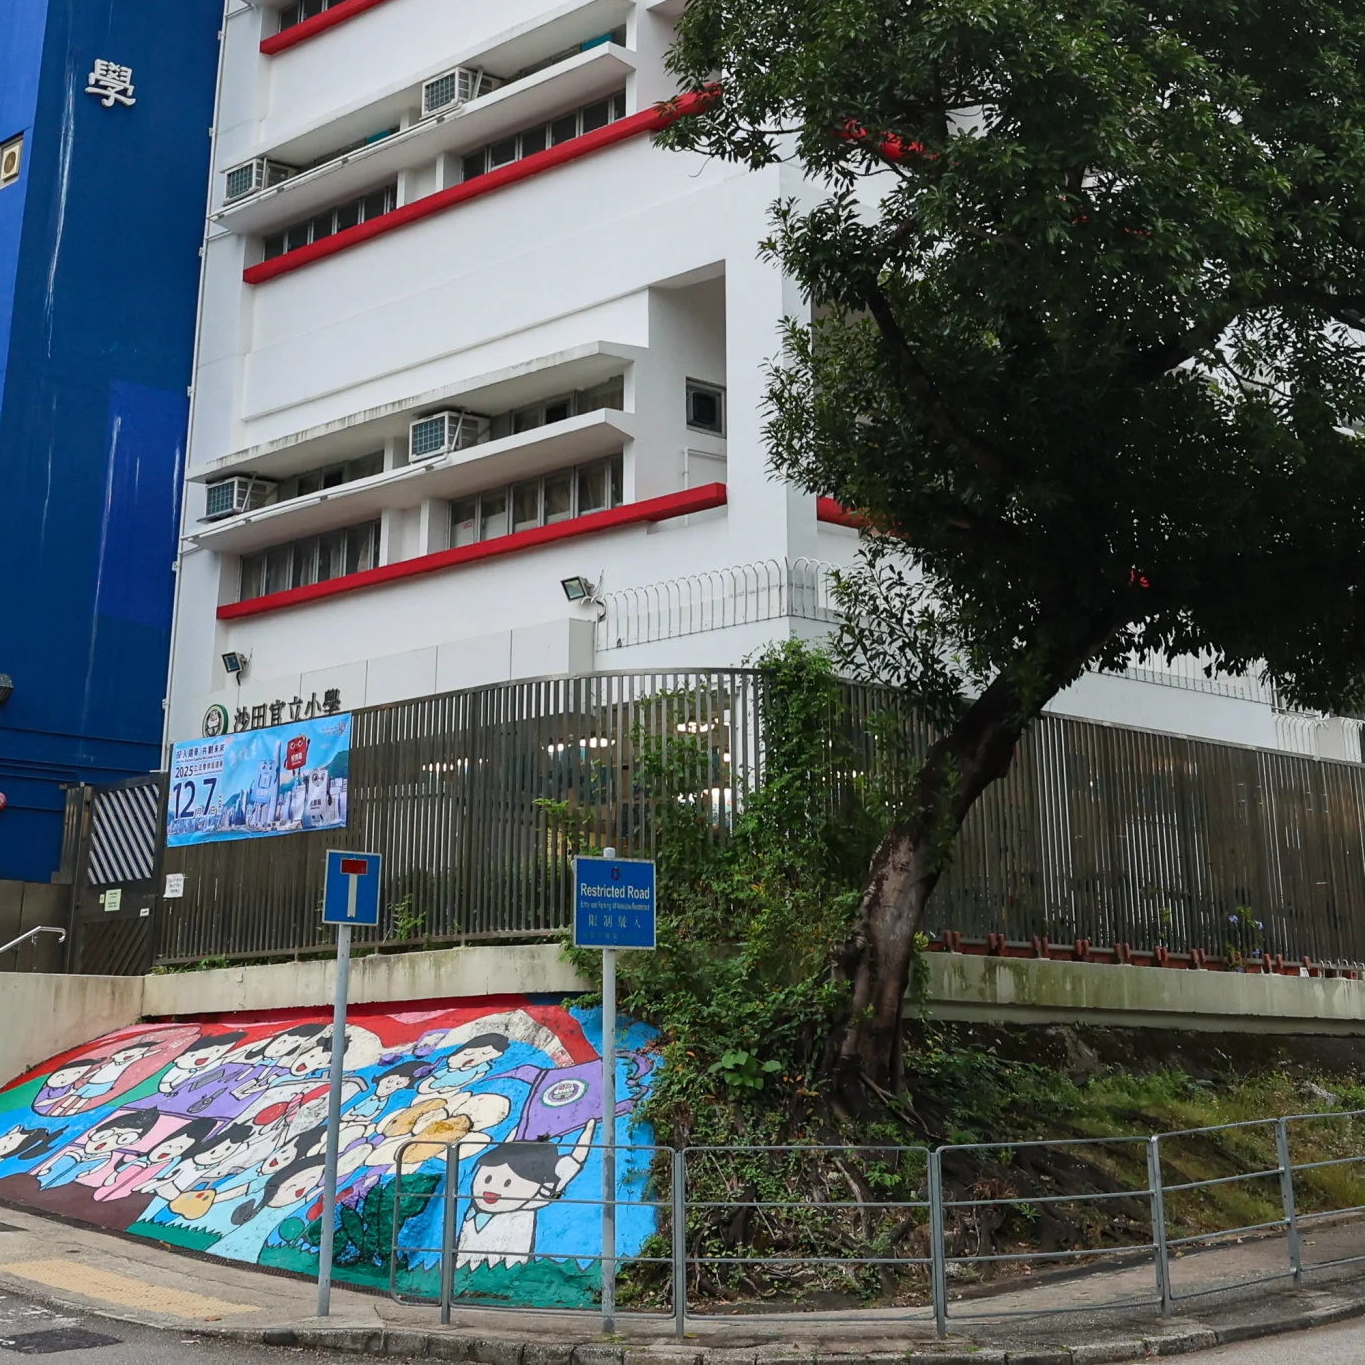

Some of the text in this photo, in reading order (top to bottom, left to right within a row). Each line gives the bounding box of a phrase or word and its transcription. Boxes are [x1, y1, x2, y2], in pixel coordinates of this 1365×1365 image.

[233, 688, 342, 733] 沙田官立小學
[175, 765, 194, 778] 2025
[580, 883, 650, 900] Restricted Road
